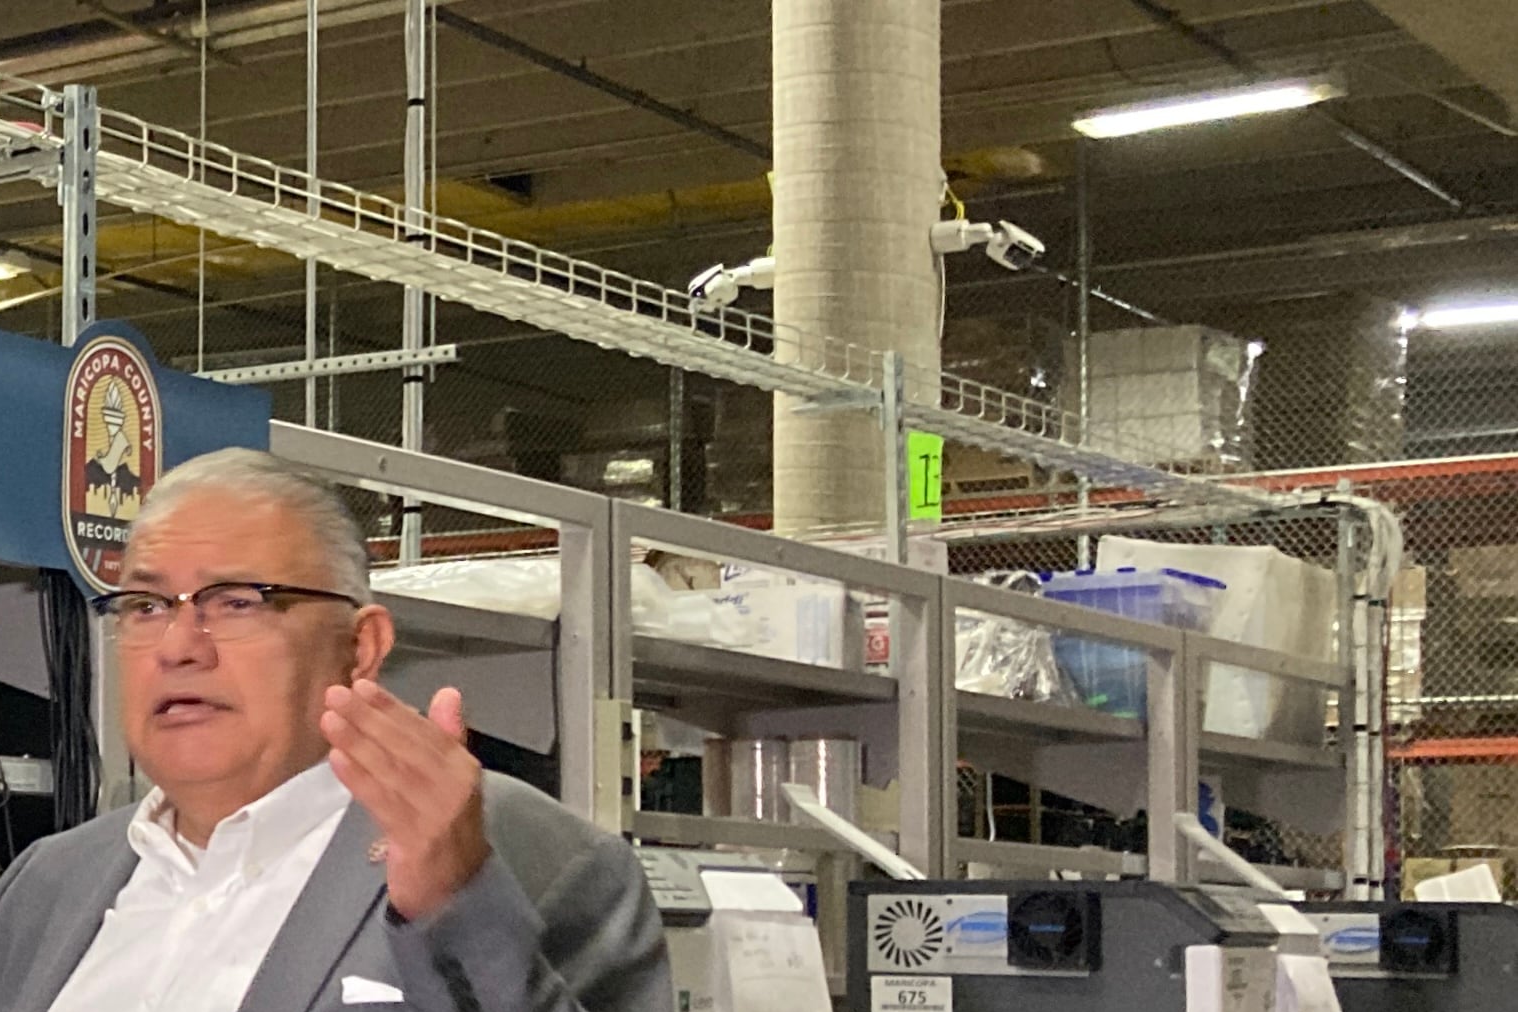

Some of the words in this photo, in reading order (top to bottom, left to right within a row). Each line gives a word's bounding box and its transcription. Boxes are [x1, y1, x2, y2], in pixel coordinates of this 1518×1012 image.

[73, 353, 121, 439] MARICOPA
[123, 362, 155, 452] COUNTY
[77, 521, 129, 543] RECORD
[898, 990, 927, 1005] 675
